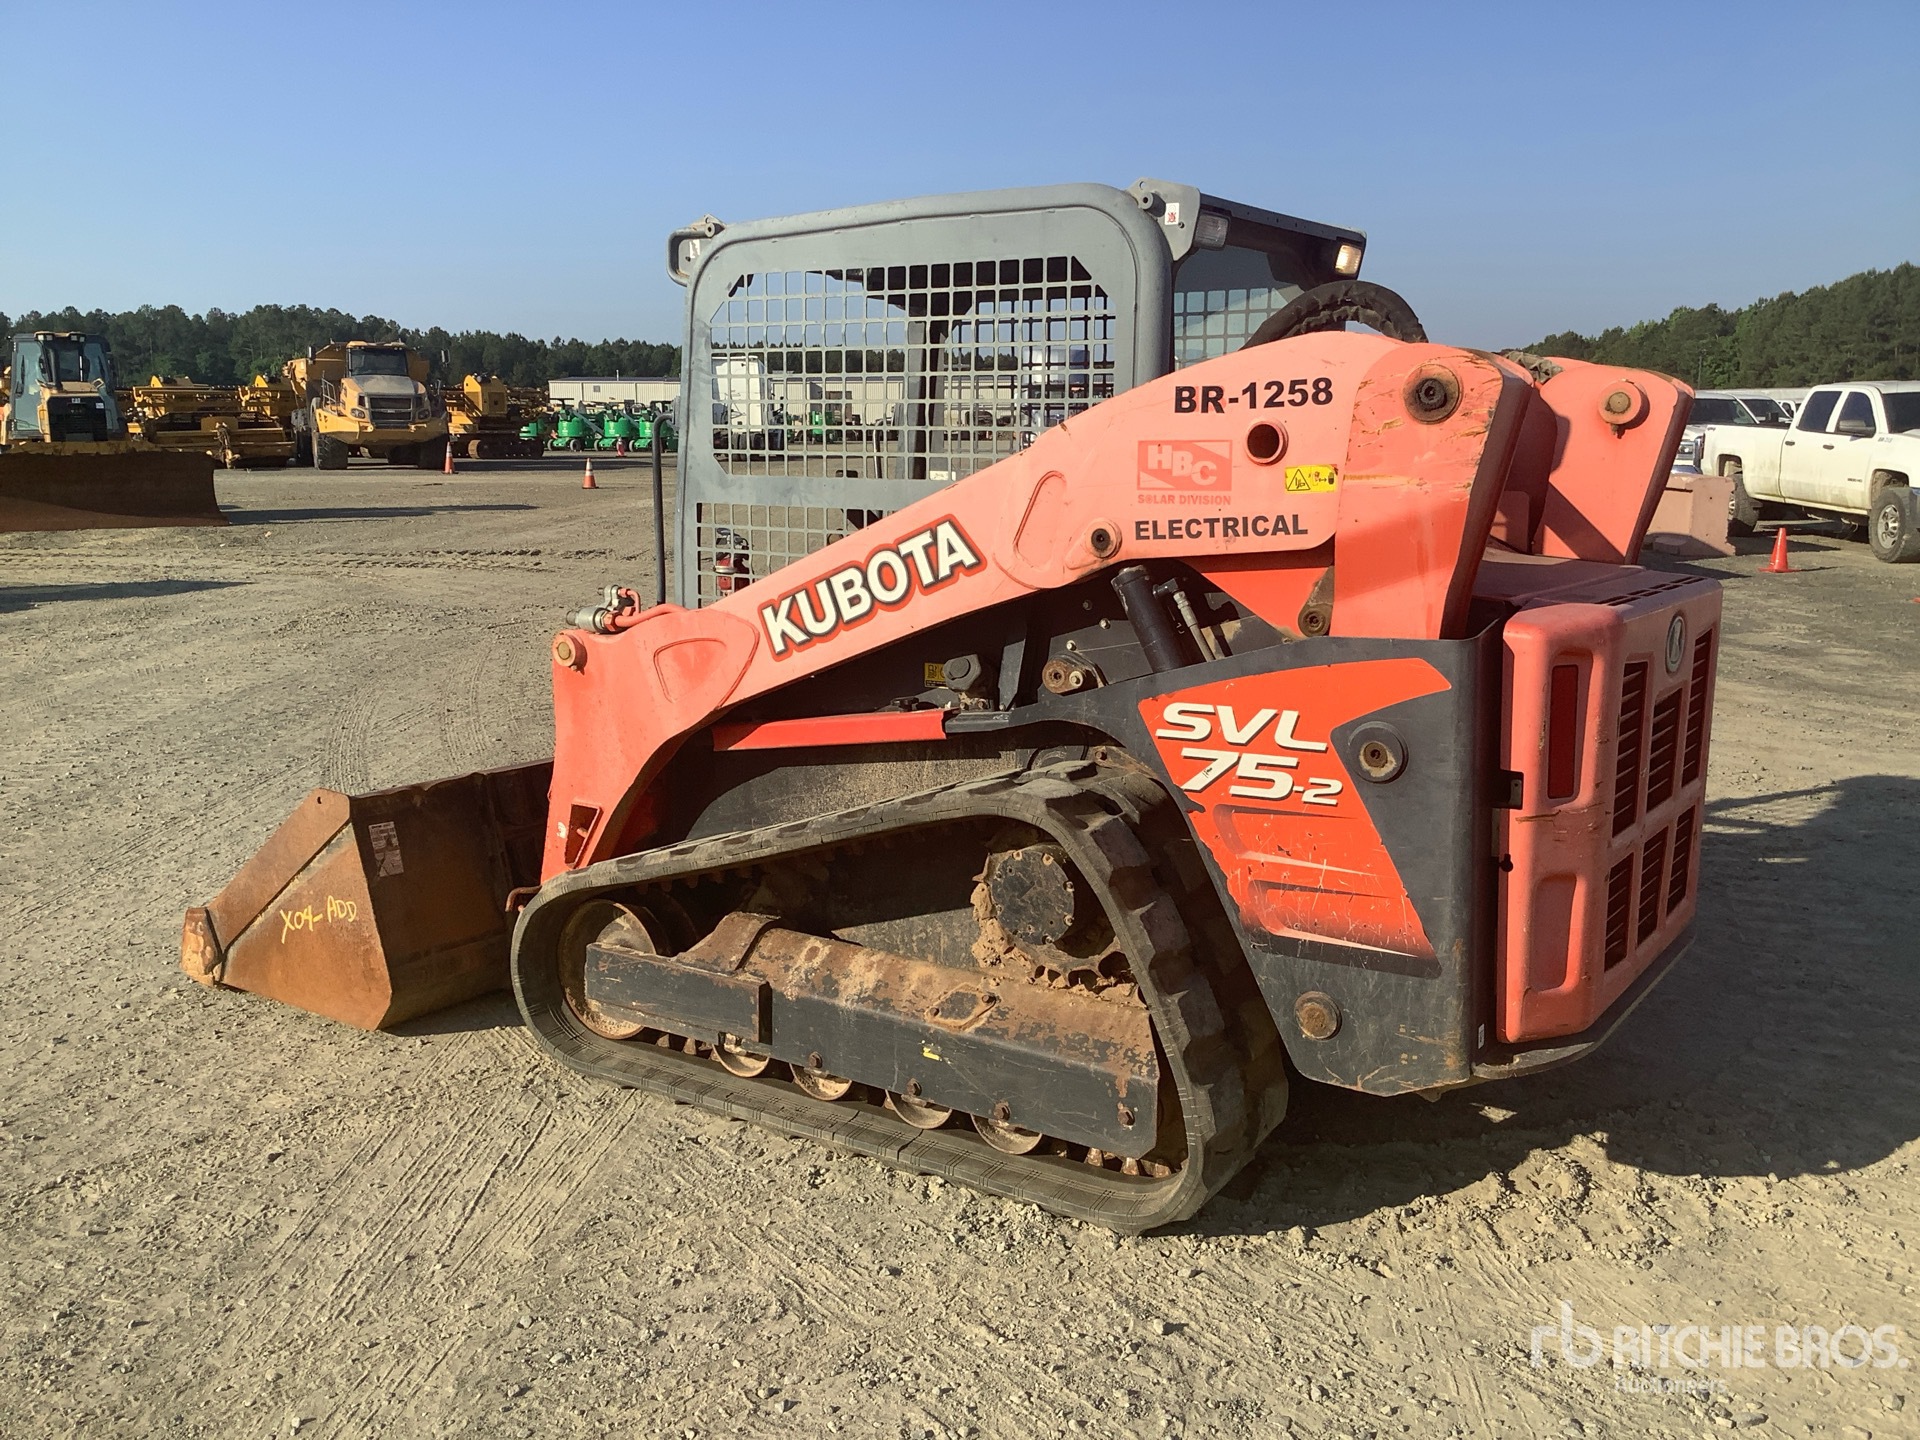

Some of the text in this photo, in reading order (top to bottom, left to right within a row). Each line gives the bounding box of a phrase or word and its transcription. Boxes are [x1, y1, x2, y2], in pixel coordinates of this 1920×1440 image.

[1174, 377, 1333, 414] BR-1258
[1147, 444, 1217, 486] HBC
[1137, 494, 1232, 506] SOLAR DIVISION
[1134, 514, 1309, 541] ELECTRICAL
[761, 520, 981, 655] KUBOTA
[1154, 702, 1328, 752] SVL
[1179, 747, 1344, 806] 75-2
